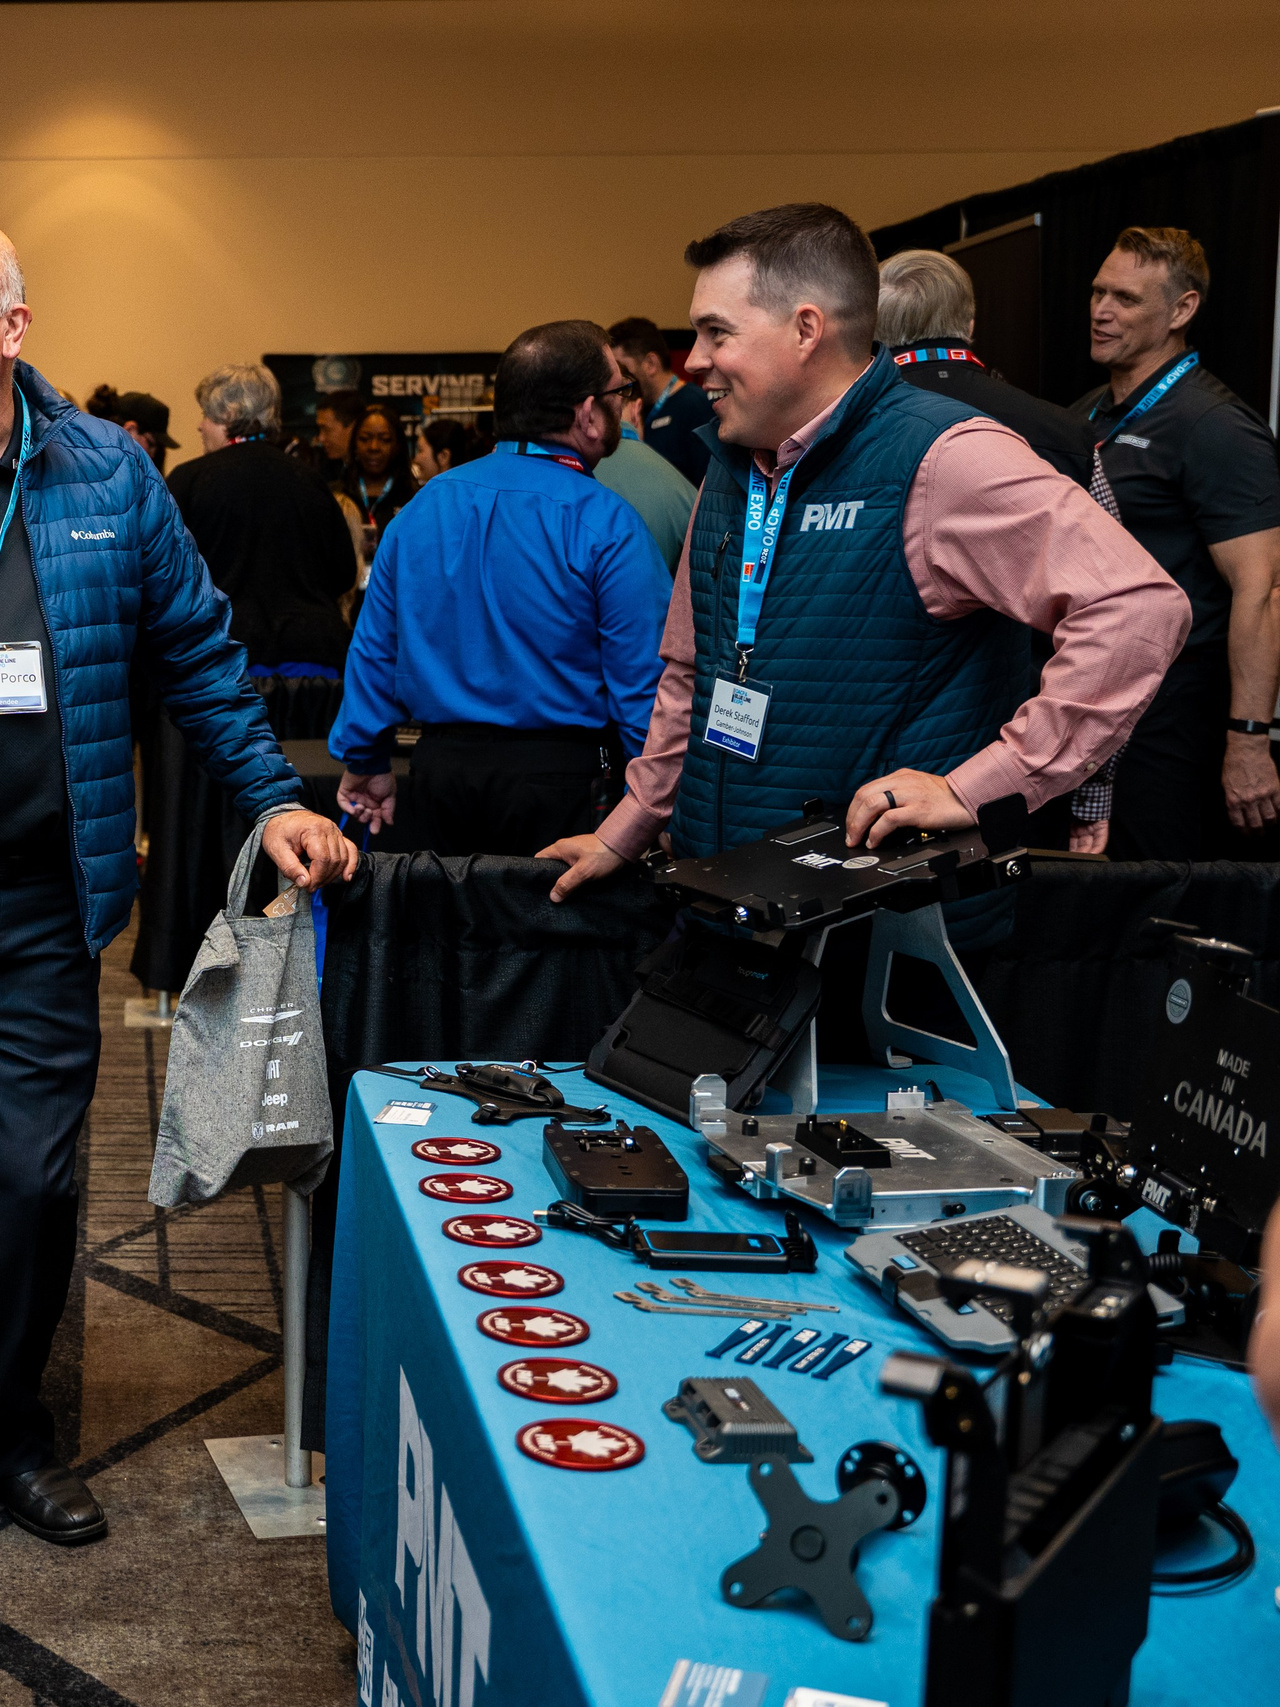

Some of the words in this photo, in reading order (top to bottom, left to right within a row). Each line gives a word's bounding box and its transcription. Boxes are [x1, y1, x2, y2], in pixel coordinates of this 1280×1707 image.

[372, 374, 484, 396] SERVING
[748, 494, 764, 531] EXPO
[762, 508, 780, 547] OACP
[775, 494, 785, 504] &
[800, 500, 865, 532] PMT
[78, 529, 116, 540] Columbia
[0, 673, 37, 683] Porco
[714, 704, 733, 719] Derek
[733, 711, 760, 728] Stafford
[794, 852, 843, 868] PMT
[240, 1034, 294, 1048] DOGE
[1217, 1049, 1251, 1078] MADE
[1221, 1075, 1235, 1096] IN
[262, 1092, 288, 1107] Jeep
[265, 1120, 299, 1133] RAM
[1173, 1080, 1268, 1158] CANADA
[1141, 1177, 1172, 1207] PMT
[395, 1364, 491, 1707] PMT
